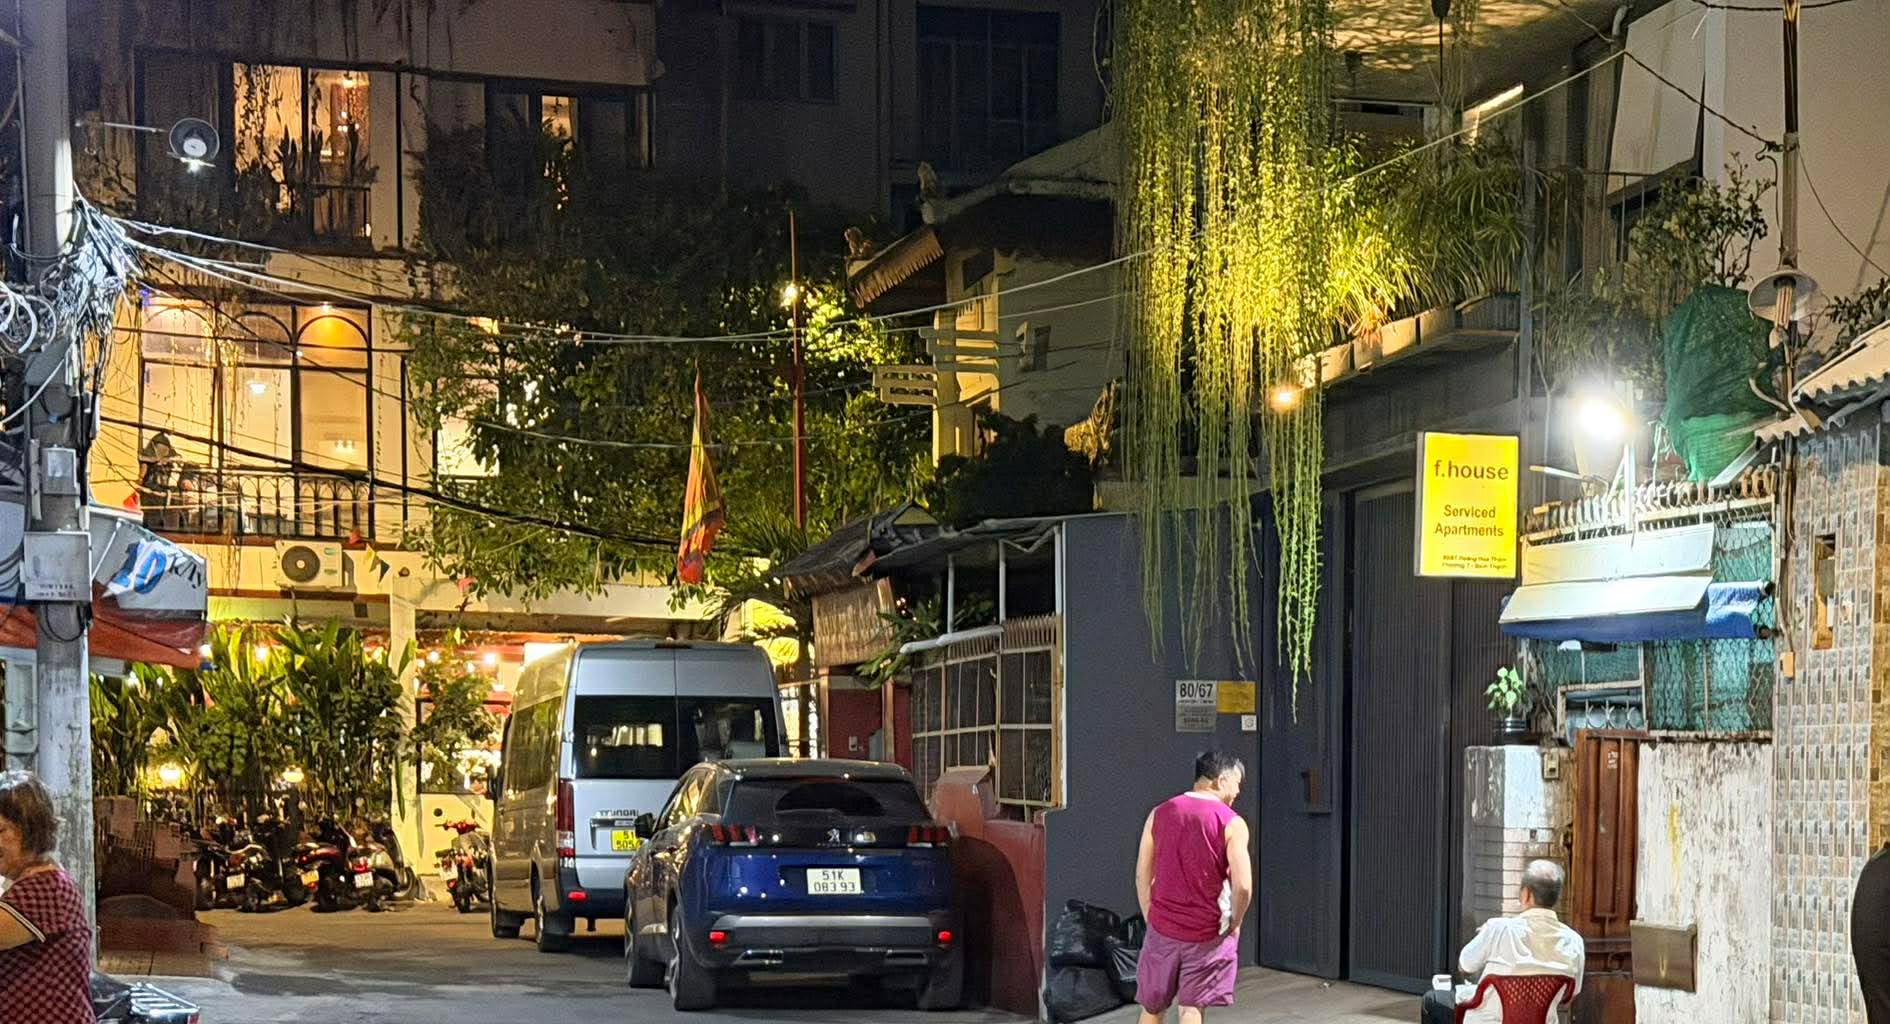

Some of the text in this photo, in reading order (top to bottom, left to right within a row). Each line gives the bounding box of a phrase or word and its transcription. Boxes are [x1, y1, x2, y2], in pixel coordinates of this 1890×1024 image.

[1434, 459, 1509, 480] f.house
[1443, 504, 1496, 518] Serviced
[1434, 523, 1504, 537] Apartments
[1180, 682, 1213, 698] 80/67
[822, 870, 844, 881] 51K
